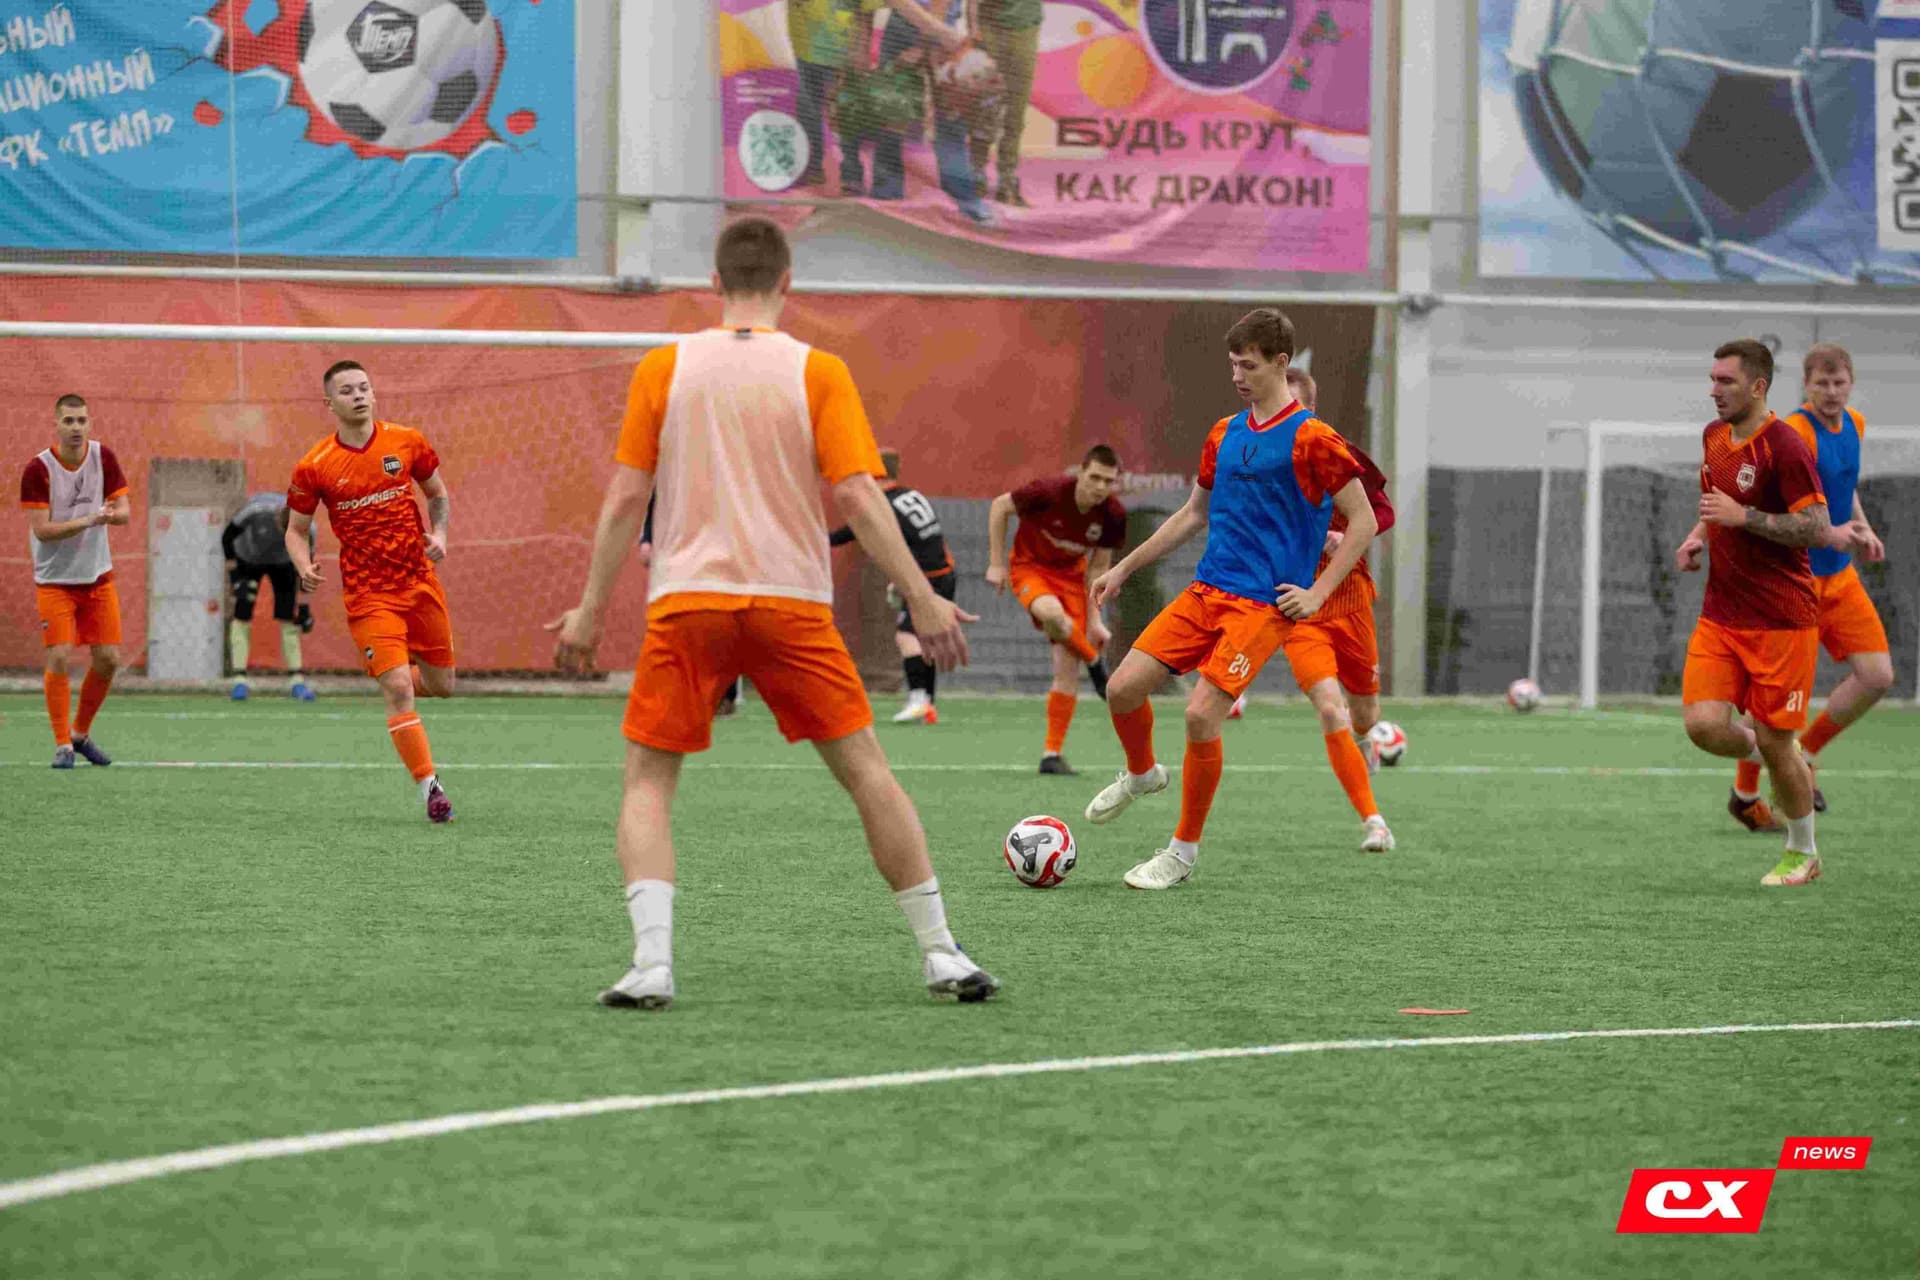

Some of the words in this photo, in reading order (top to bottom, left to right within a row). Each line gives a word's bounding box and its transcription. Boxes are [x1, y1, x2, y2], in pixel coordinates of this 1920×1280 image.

[0, 130, 48, 170] ФК
[59, 109, 175, 157] «ТЕМП»
[1056, 117, 1187, 154] БУДЬ
[1201, 120, 1312, 157] КРУТ,
[1055, 172, 1137, 202] КАК
[1152, 174, 1334, 207] ДРАКОН!
[1228, 653, 1250, 680] 24
